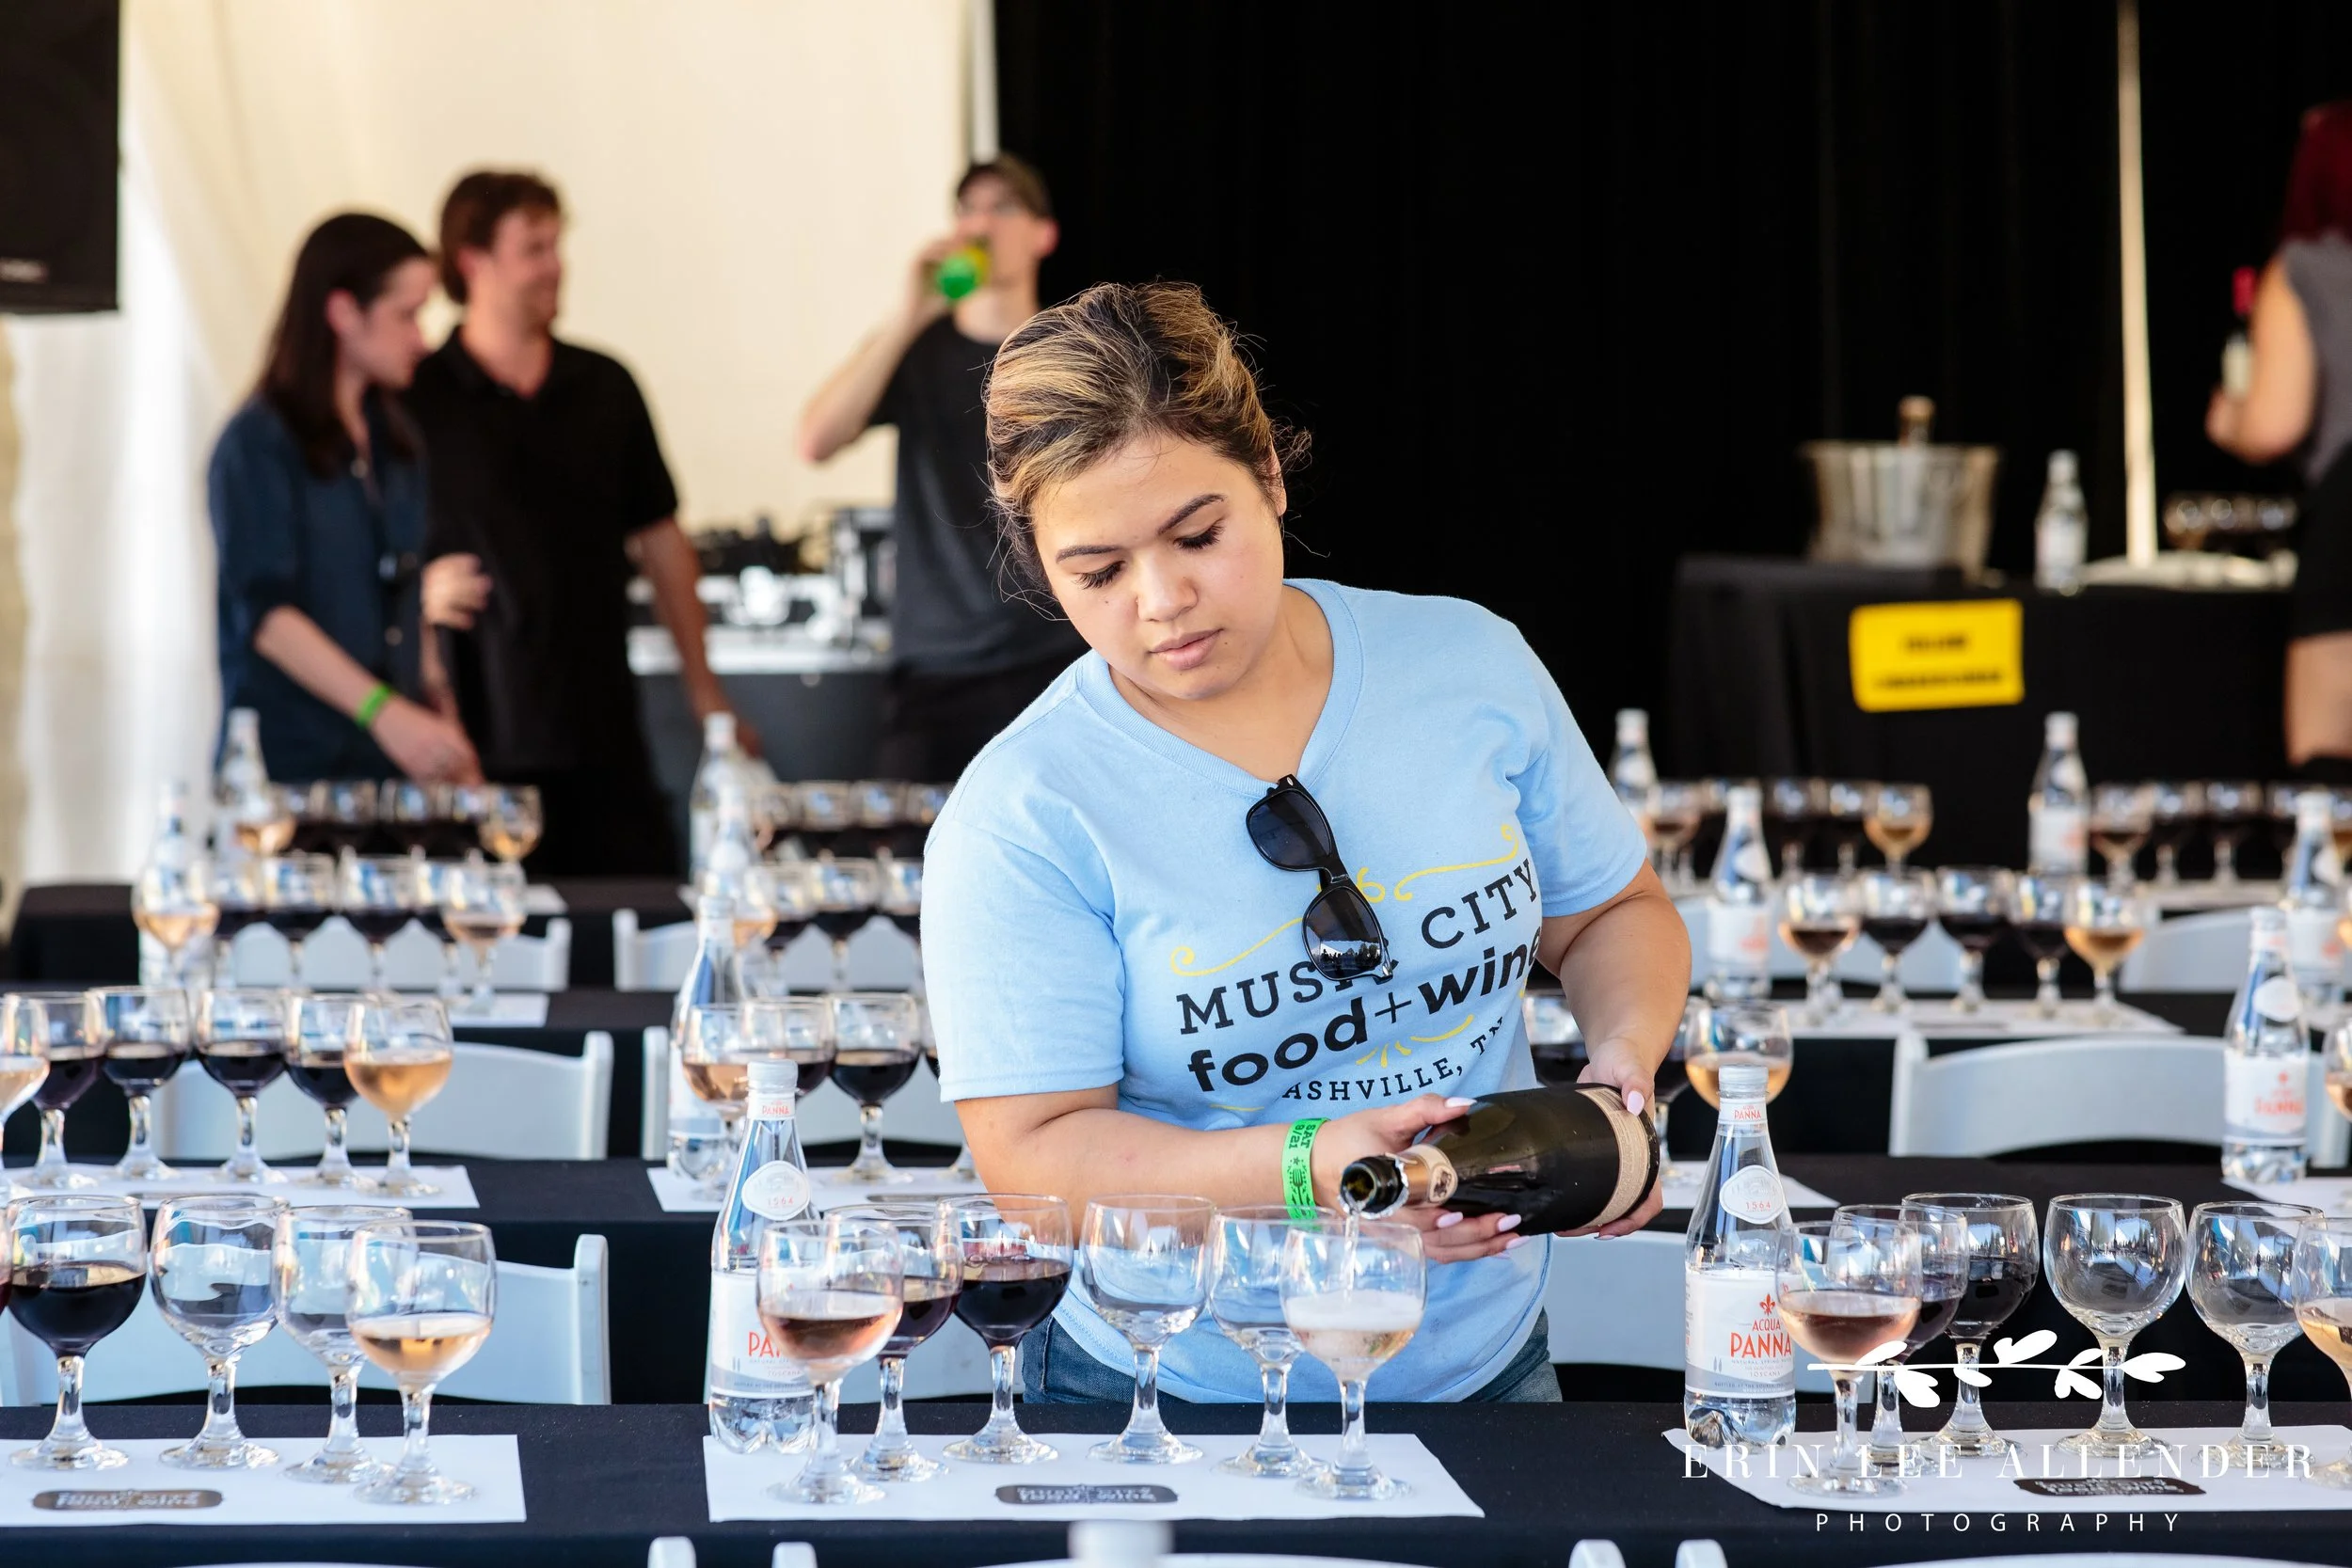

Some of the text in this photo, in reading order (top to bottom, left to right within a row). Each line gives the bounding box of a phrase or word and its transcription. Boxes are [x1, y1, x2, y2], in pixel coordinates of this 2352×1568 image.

[1176, 858, 1537, 1035] MUS CITY
[1281, 1057, 1464, 1101] ASHVILLE,
[1734, 1109, 1761, 1119] PANNA
[1752, 1319, 1781, 1331] ACQUA
[748, 1331, 780, 1358] PA
[1730, 1332, 1792, 1359] PANNA
